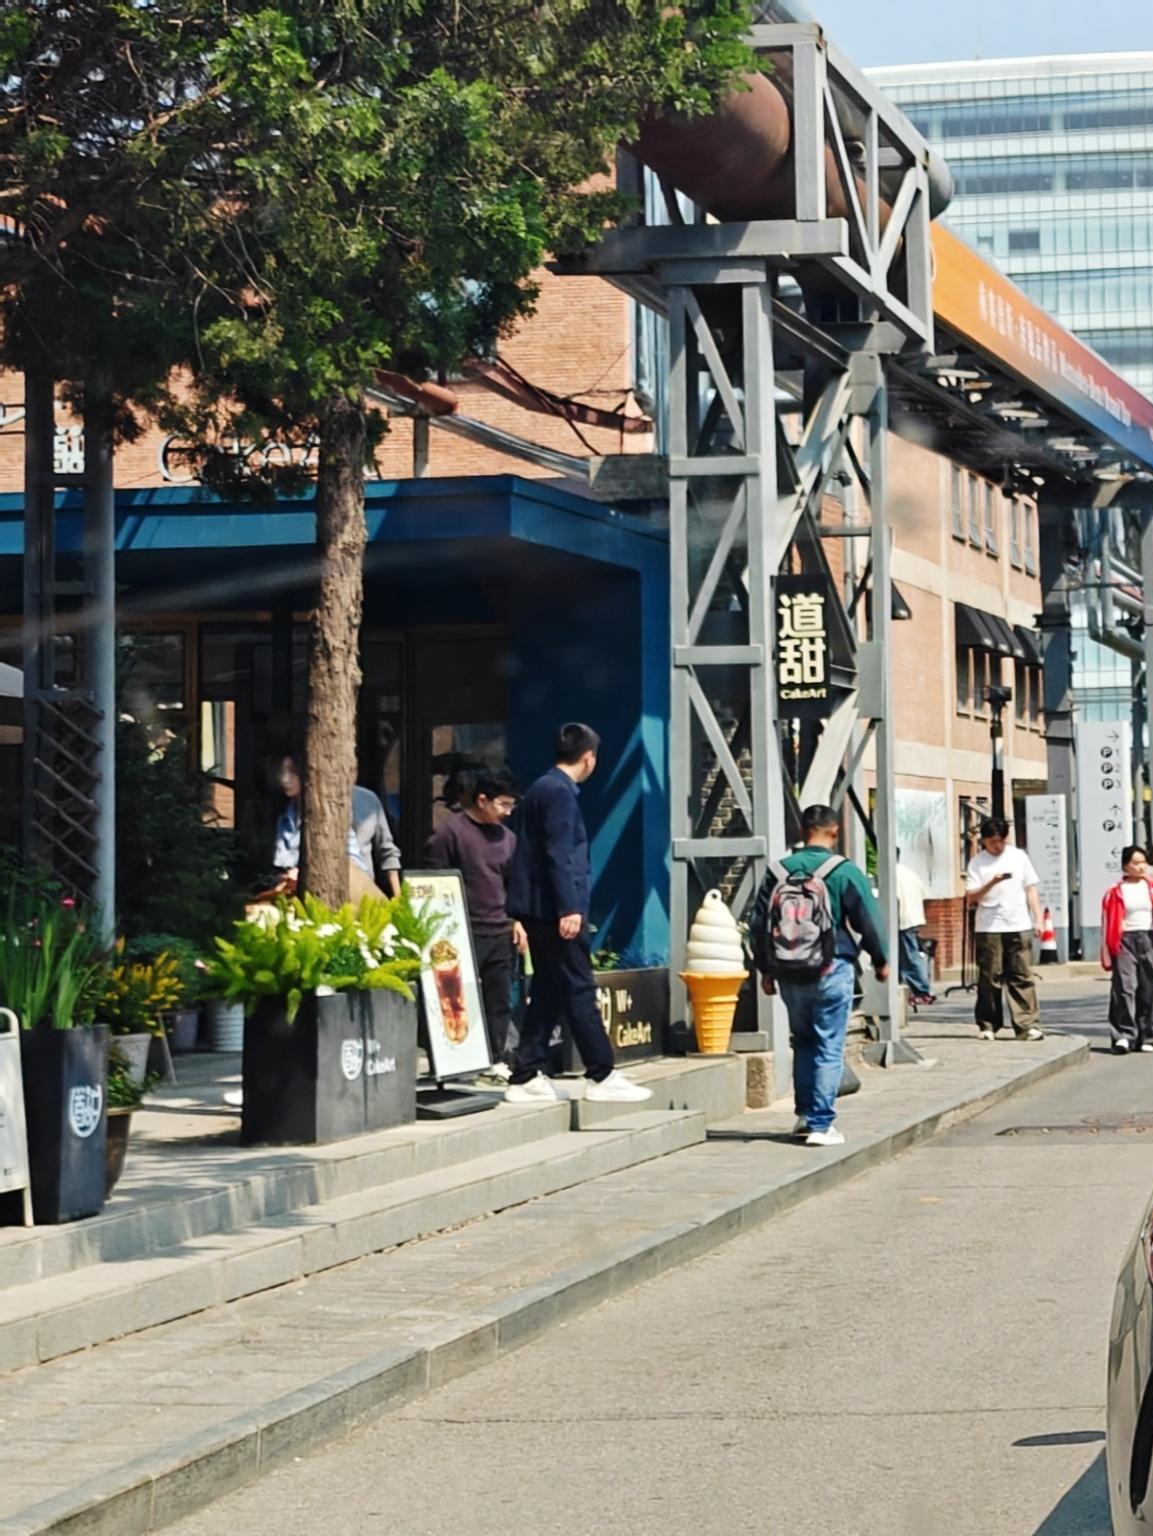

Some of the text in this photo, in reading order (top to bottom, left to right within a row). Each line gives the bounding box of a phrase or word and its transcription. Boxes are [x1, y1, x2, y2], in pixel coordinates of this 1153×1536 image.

[778, 593, 826, 685] 道甜
[615, 988, 632, 1012] W+
[617, 1021, 652, 1048] CakeArt
